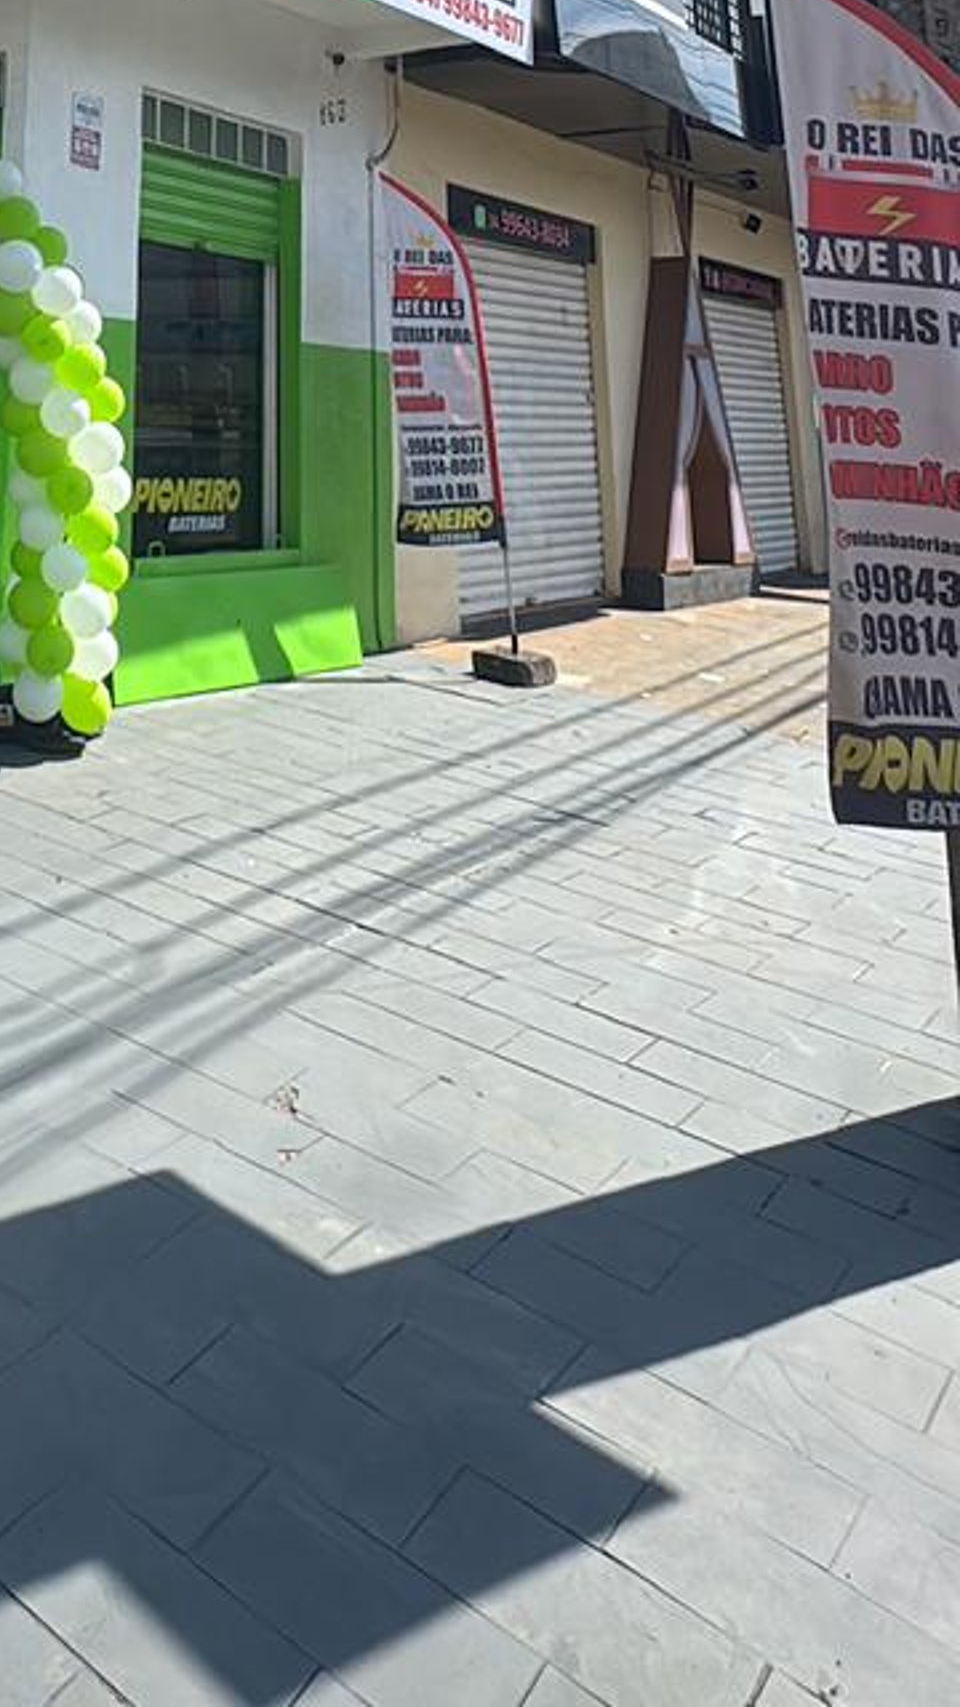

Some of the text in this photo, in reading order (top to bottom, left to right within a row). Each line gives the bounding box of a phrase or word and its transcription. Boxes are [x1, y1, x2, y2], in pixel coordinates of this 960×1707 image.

[807, 120, 960, 167] O REI DAS
[131, 476, 242, 513] PIONEIRO
